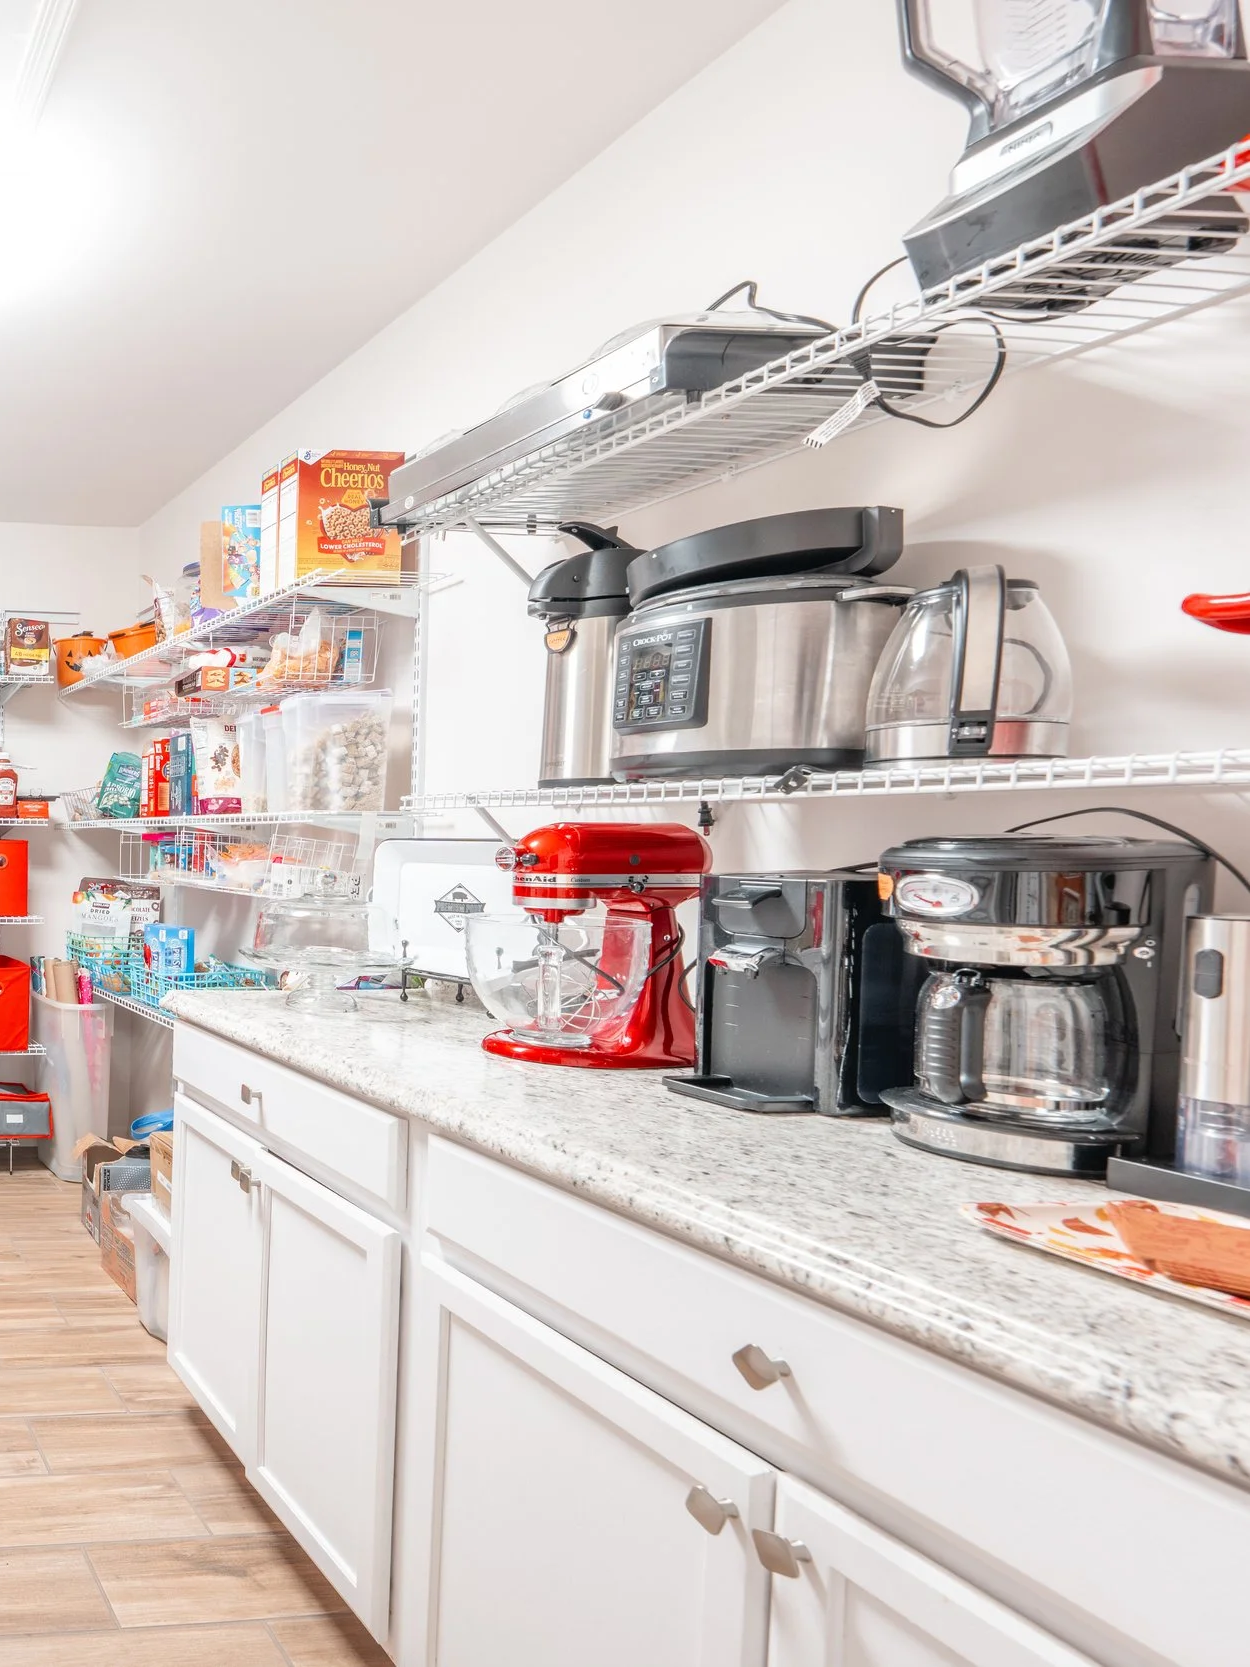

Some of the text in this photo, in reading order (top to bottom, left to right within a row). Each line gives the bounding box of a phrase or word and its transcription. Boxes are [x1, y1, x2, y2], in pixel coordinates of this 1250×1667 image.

[344, 462, 365, 472] Honey
[367, 463, 380, 472] Nut
[320, 467, 385, 490] Cheerios
[343, 541, 383, 549] CHOLESTEROL
[14, 623, 46, 637] Senseo
[81, 912, 119, 922] MANGOES
